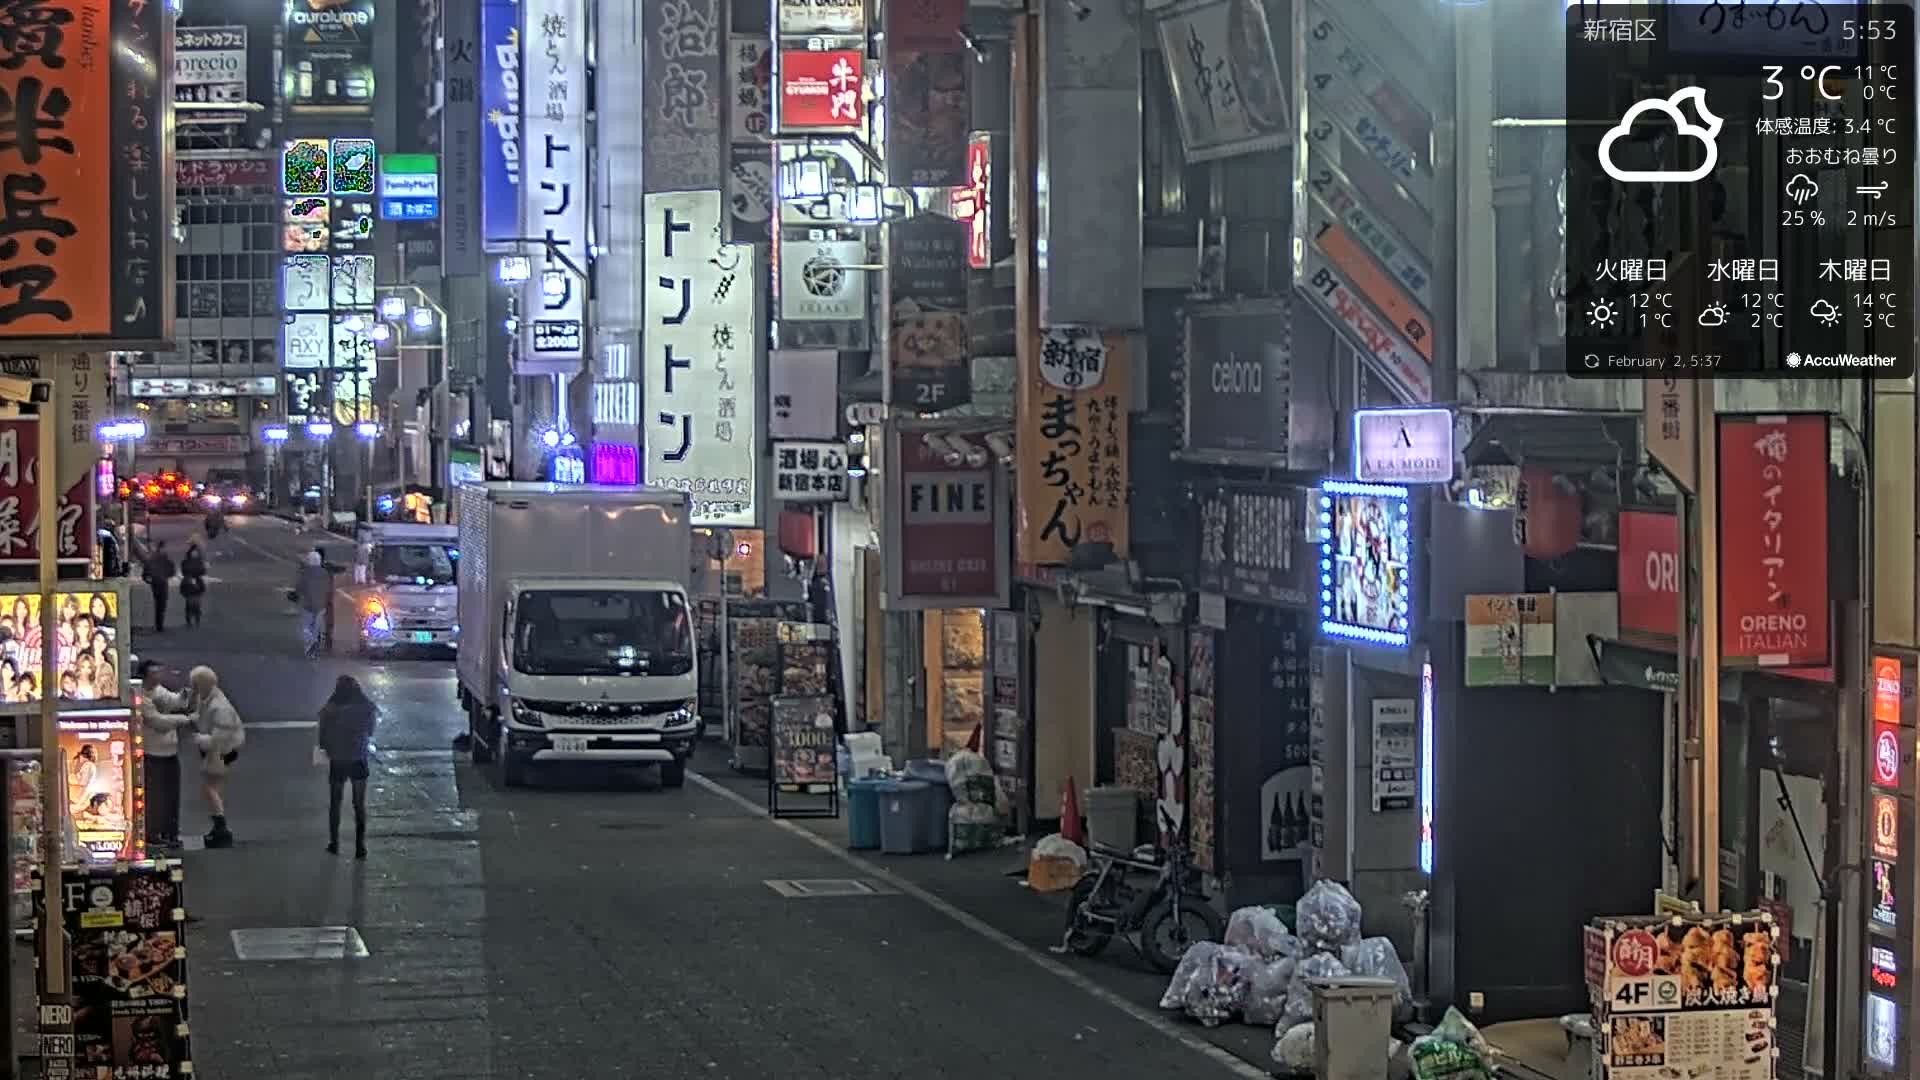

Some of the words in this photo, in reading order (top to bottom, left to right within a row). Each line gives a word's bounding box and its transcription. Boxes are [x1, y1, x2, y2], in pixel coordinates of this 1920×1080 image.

[1313, 20, 1334, 41] 5
[1313, 73, 1332, 90] 4
[1313, 120, 1334, 142] 3
[385, 180, 435, 192] FamilyMart
[1312, 170, 1333, 193] 2
[1311, 267, 1340, 297] B1
[658, 207, 692, 461] トントン
[71, 351, 91, 442] 通り一番街
[915, 383, 945, 404] 2F
[1040, 395, 1085, 548] まっちゃん
[910, 483, 986, 513] FINE
[1753, 429, 1788, 602] 俺のイタリアン
[1740, 614, 1807, 632] ORENO
[1738, 633, 1809, 654] ITALIAN
[1616, 982, 1649, 1005] 4F
[41, 1005, 73, 1025] NERO
